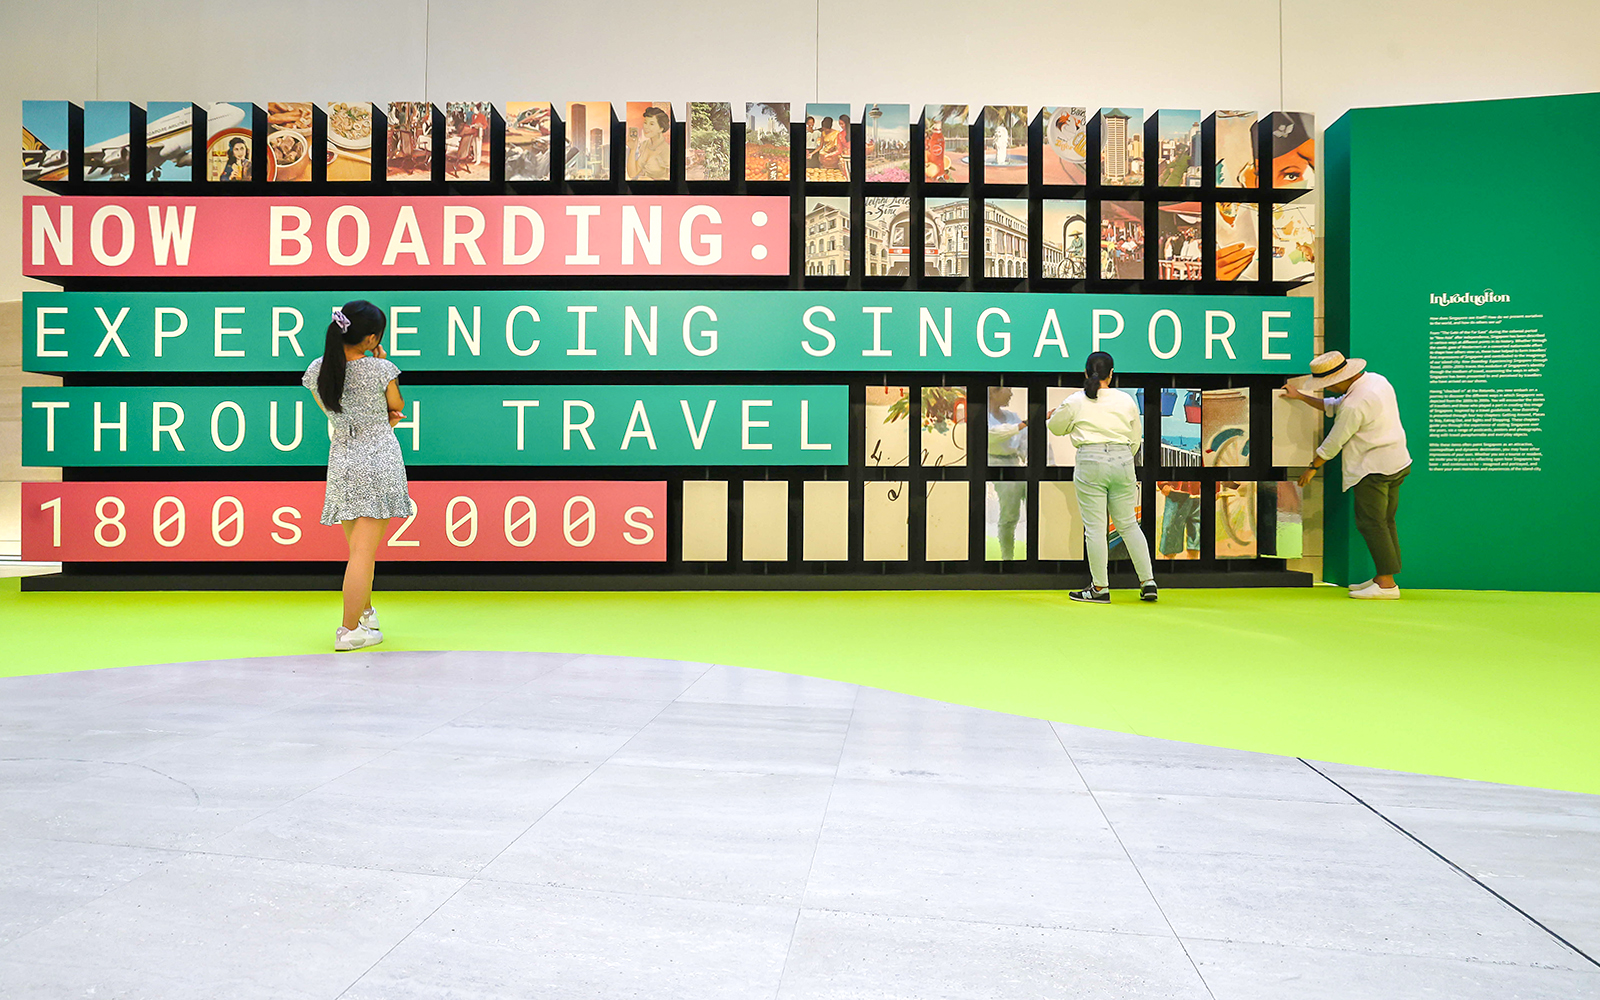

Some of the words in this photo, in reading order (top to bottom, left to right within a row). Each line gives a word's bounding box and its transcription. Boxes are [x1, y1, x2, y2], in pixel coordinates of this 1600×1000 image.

[32, 205, 197, 266] NOW
[269, 204, 770, 265] BOARDING:
[1430, 288, 1511, 306] Introduction
[36, 305, 719, 358] EXPERENCING
[801, 305, 1292, 361] SINGAPORE
[32, 400, 420, 453] THROUH
[502, 399, 832, 451] TRAVEL
